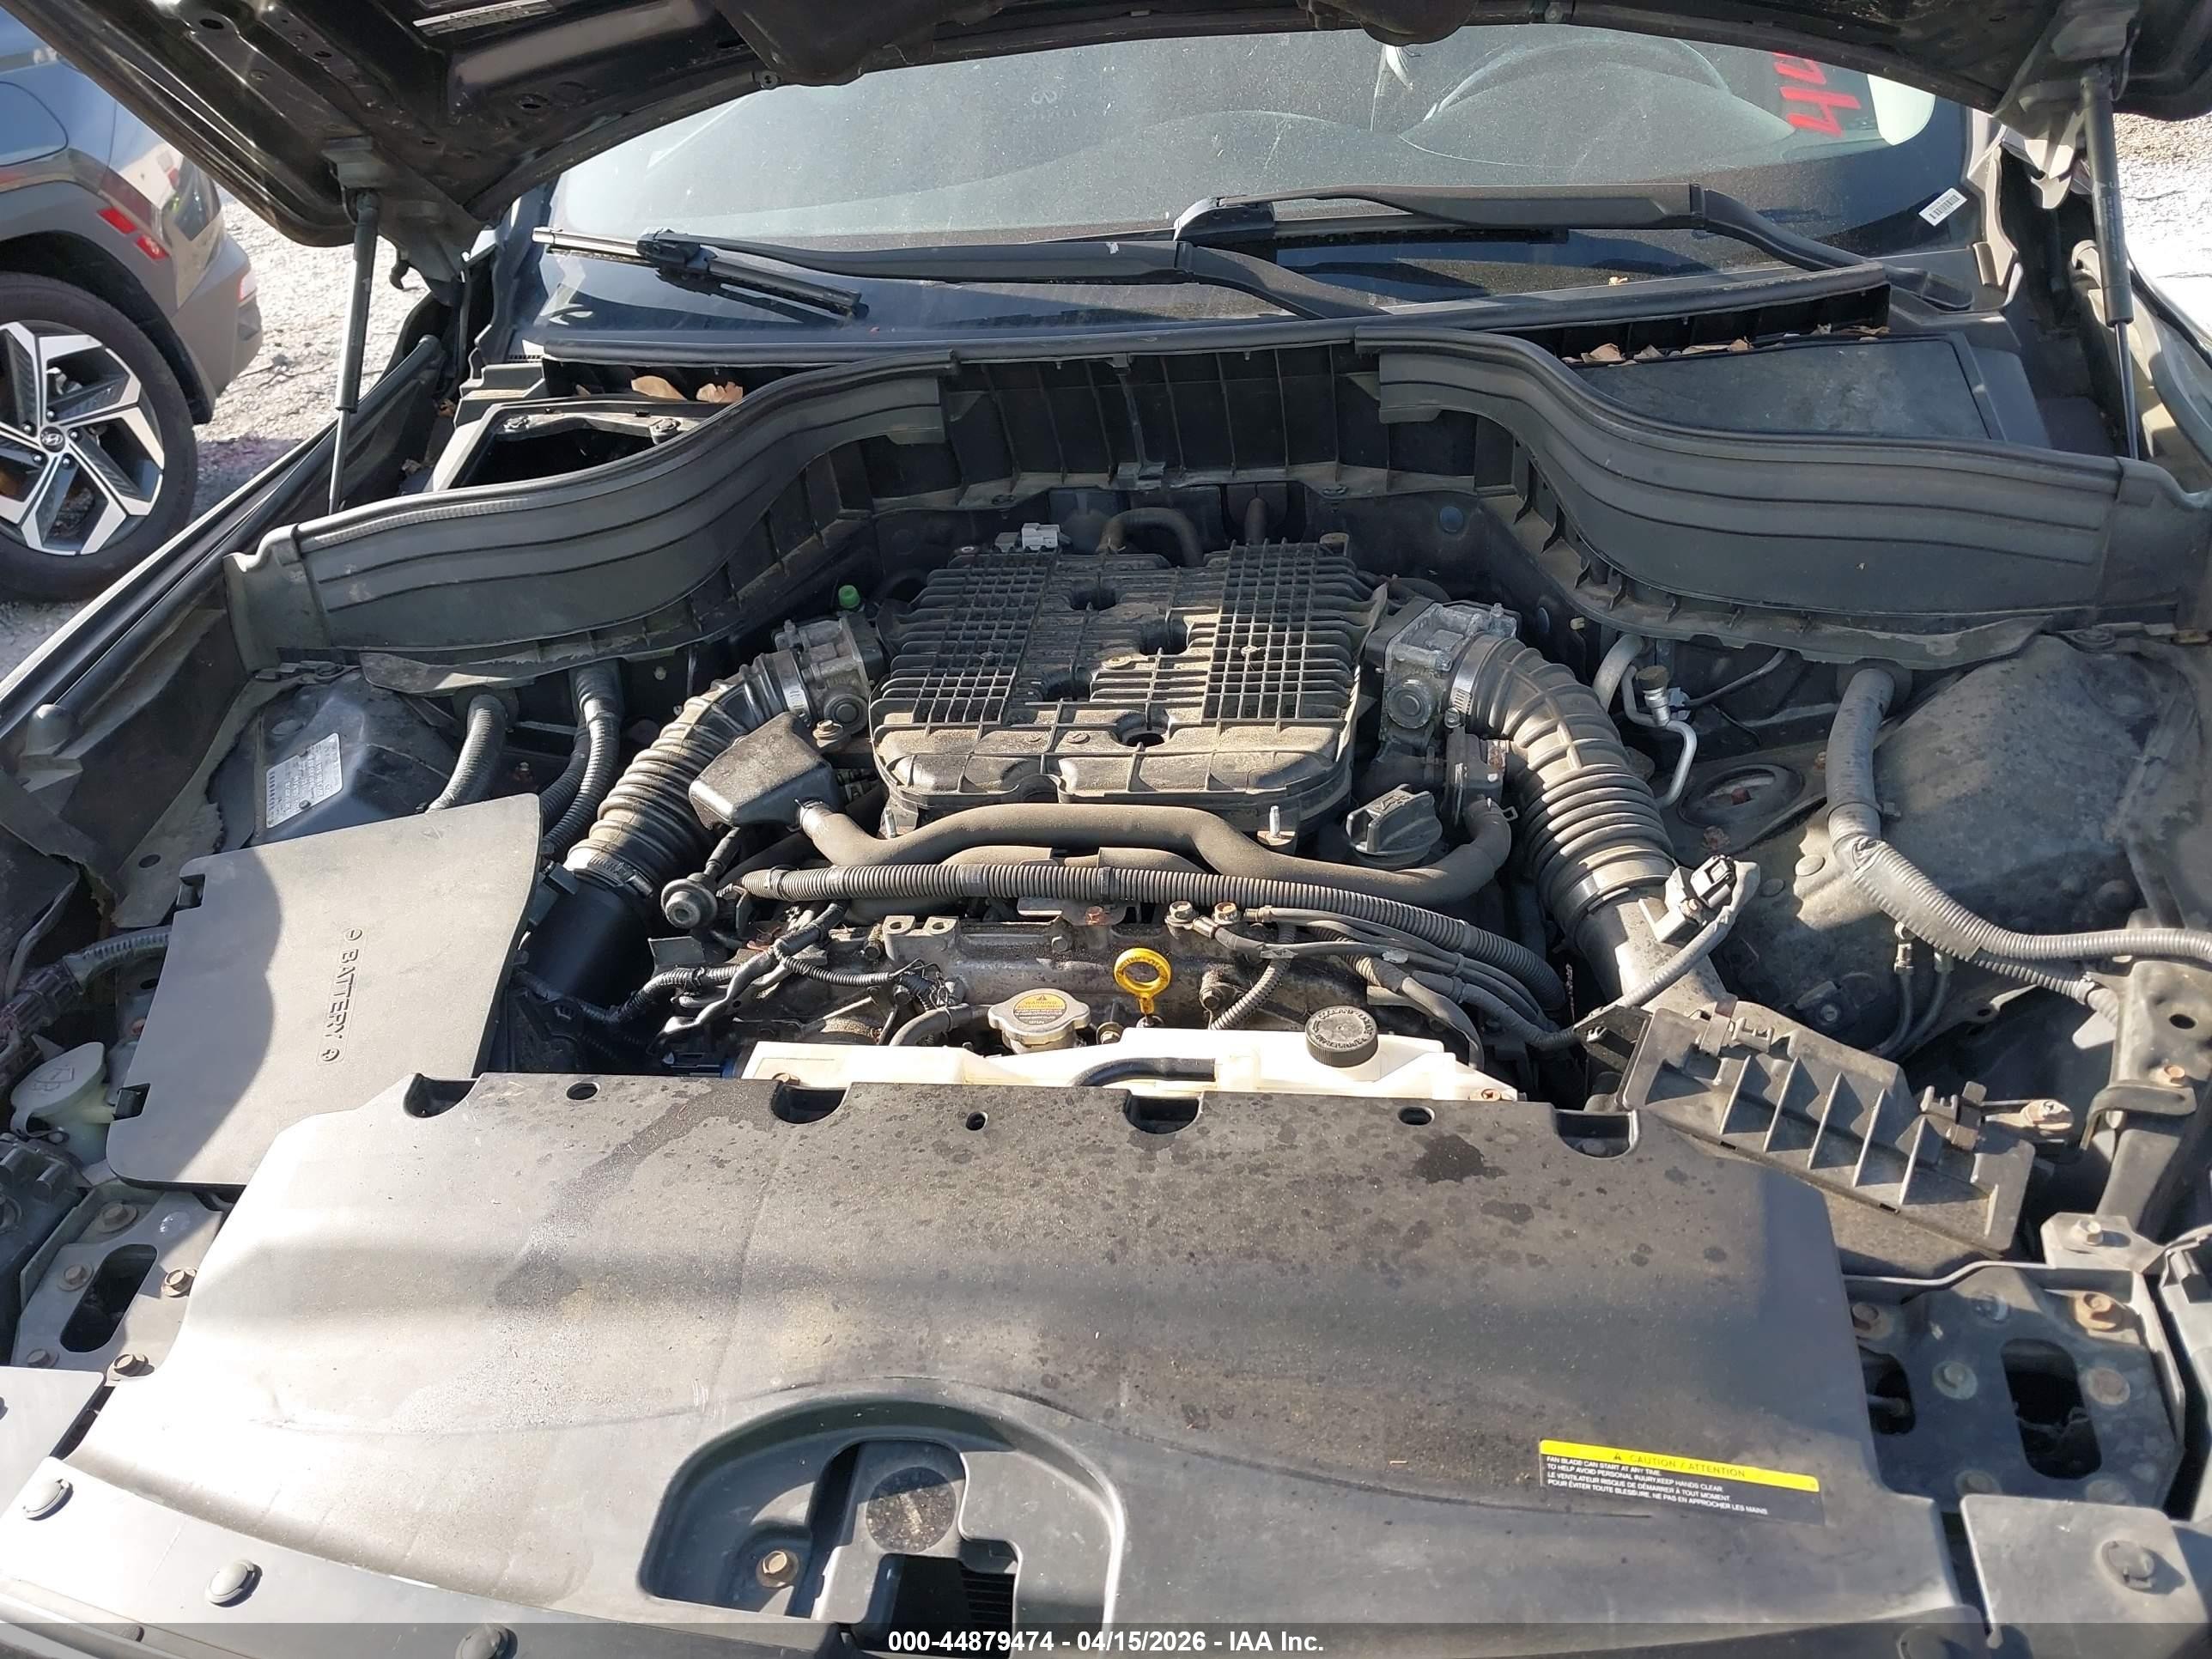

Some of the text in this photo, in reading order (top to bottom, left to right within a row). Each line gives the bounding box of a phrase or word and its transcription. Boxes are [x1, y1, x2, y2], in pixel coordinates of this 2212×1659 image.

[325, 948, 359, 1039] BATTERY
[1629, 1454, 1676, 1467] CAUTION
[1687, 1462, 1746, 1478] ATTENTION
[1557, 1473, 1600, 1483] VENTILATEUR
[1601, 1478, 1626, 1486] RISQUE
[1638, 1482, 1674, 1493] DÉMARRER
[1597, 1469, 1633, 1480] PERSONAL
[1675, 1480, 1699, 1488] HANDS
[1568, 1480, 1591, 1490] ÉVITER
[1592, 1484, 1614, 1493] TOUTE
[1688, 1498, 1731, 1510] APPROCHER
[1731, 1504, 1745, 1512] LES
